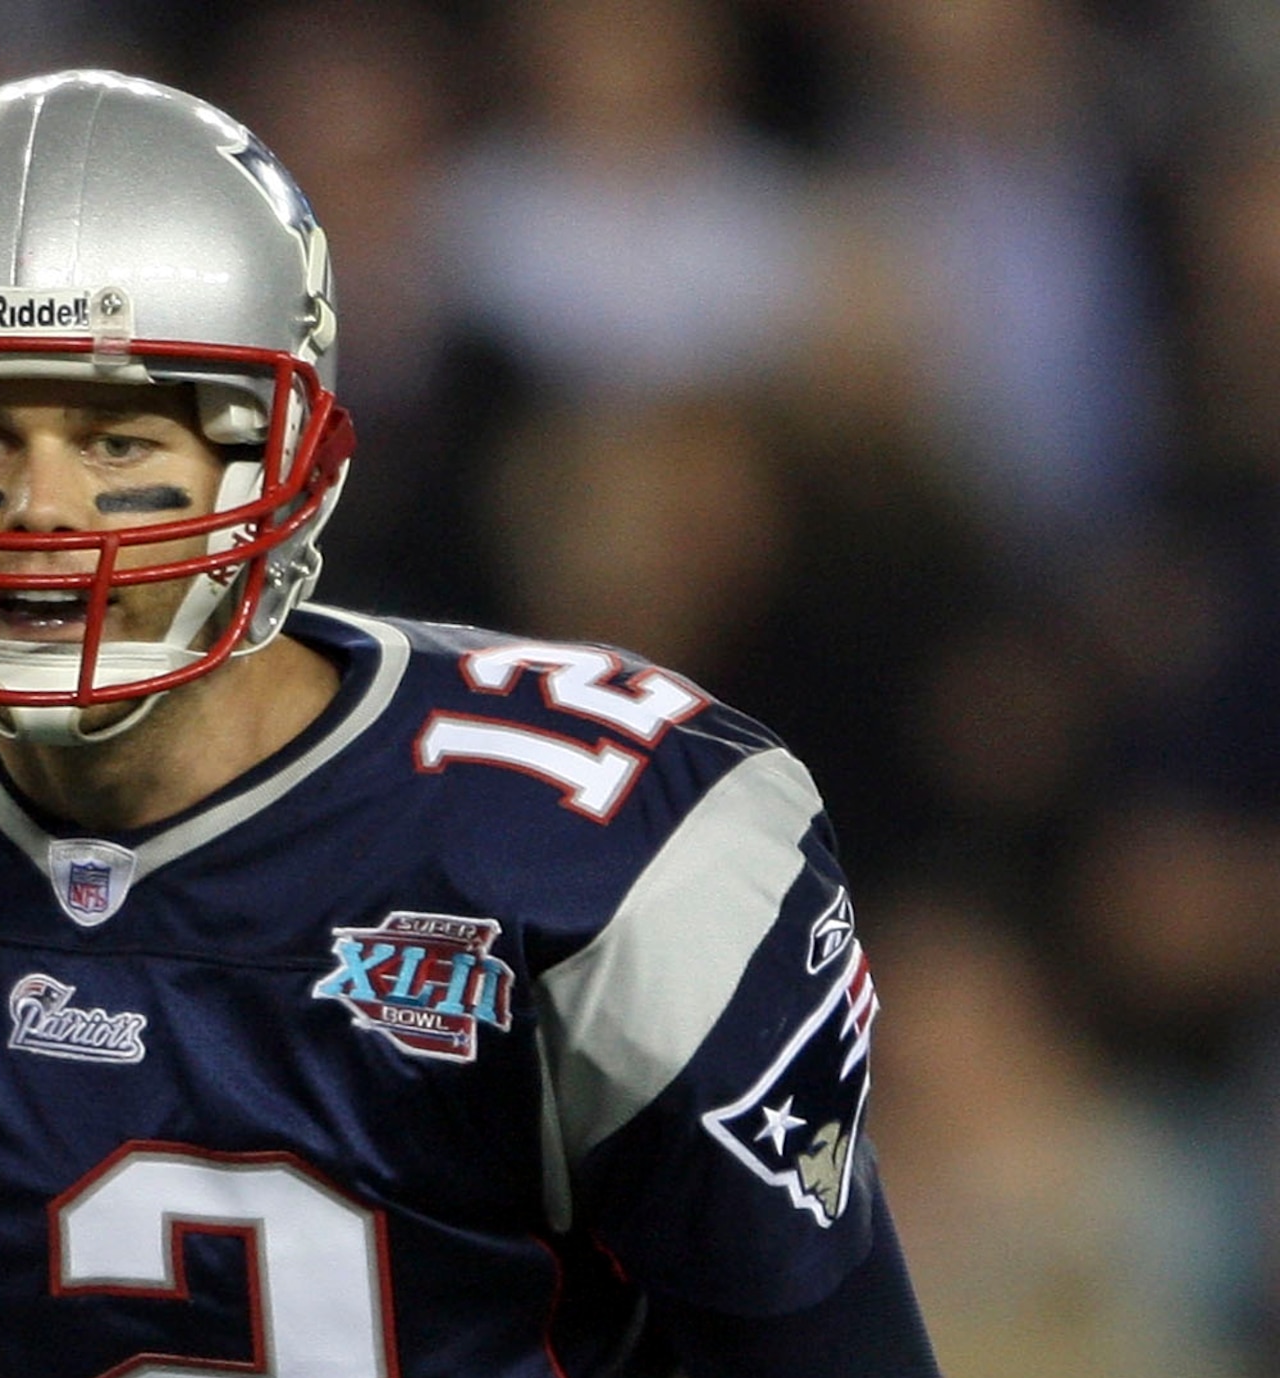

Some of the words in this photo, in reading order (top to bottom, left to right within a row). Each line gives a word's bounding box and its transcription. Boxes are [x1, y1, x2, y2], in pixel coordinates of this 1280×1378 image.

[412, 645, 710, 826] 12
[396, 916, 478, 940] SUPER
[318, 941, 502, 1024] XLII
[14, 998, 144, 1056] Patriots
[382, 1005, 450, 1031] BOWL
